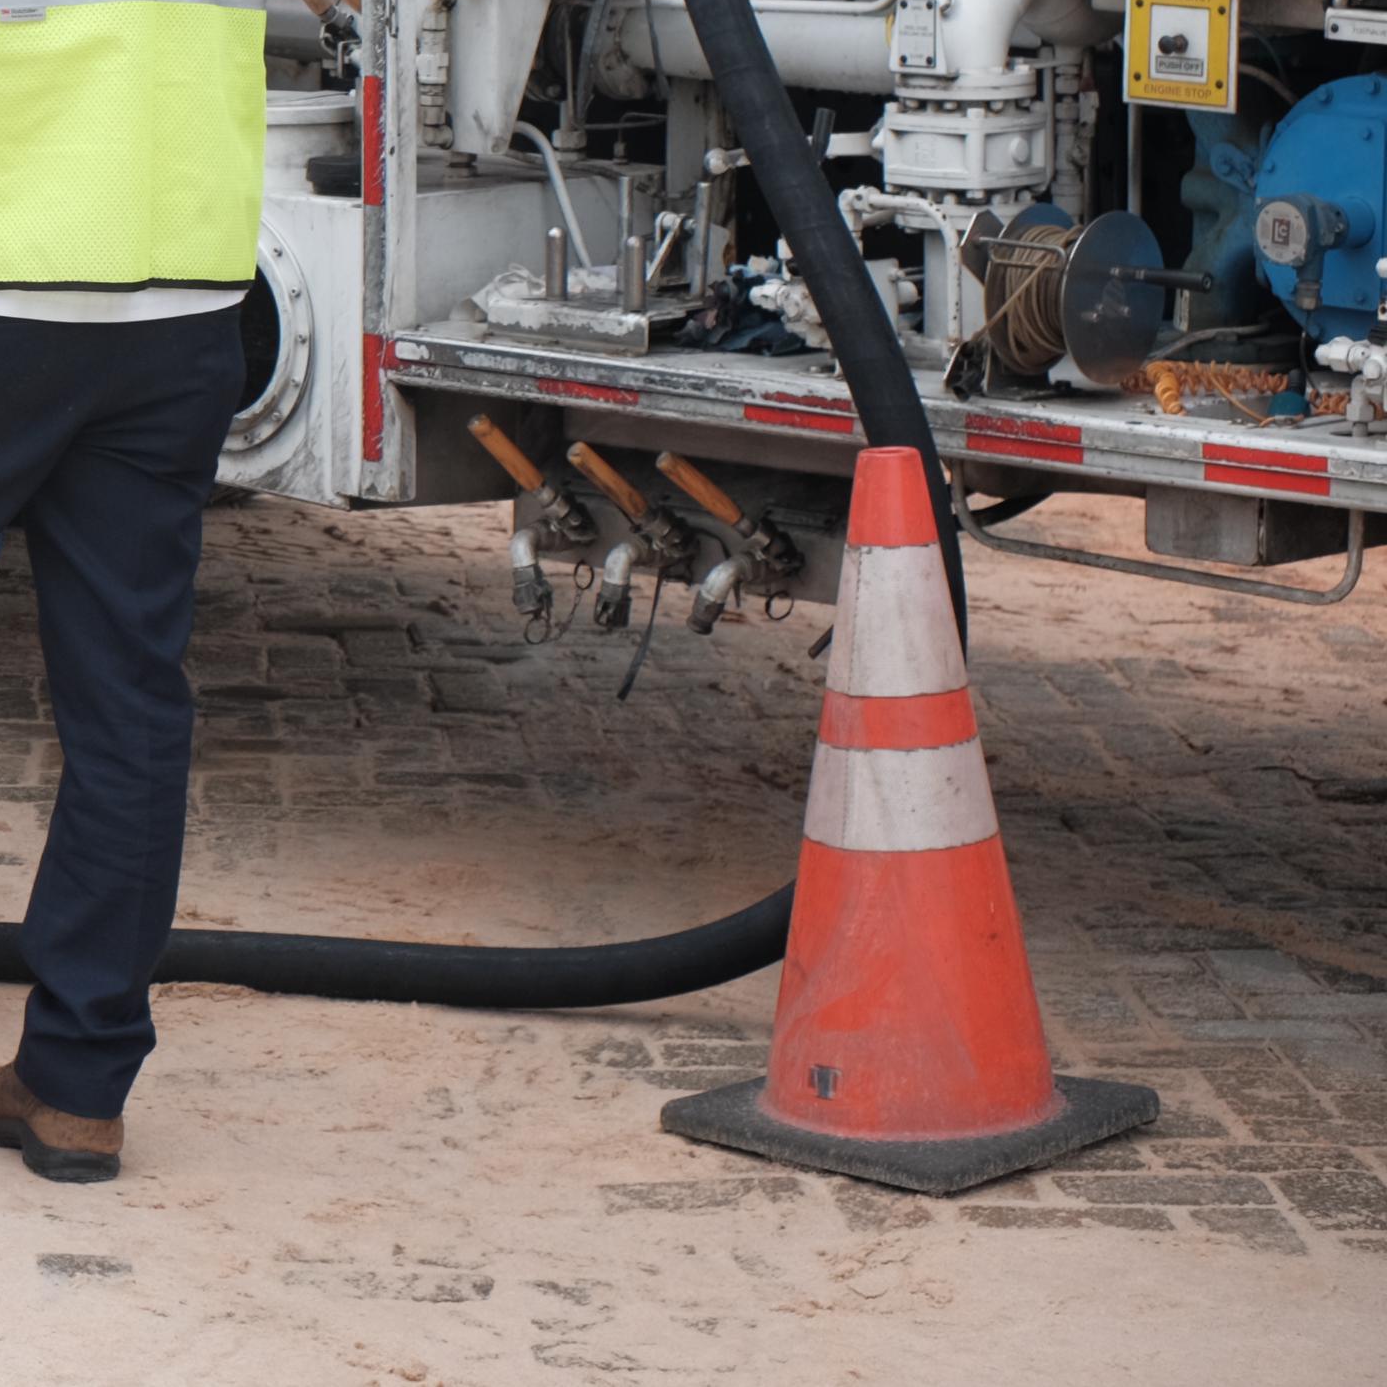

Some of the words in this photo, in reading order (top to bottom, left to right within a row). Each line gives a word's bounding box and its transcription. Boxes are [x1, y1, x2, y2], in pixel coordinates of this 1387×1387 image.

[1183, 61, 1201, 72] OFF
[1143, 84, 1182, 98] ENGINE
[1184, 85, 1213, 99] STOP
